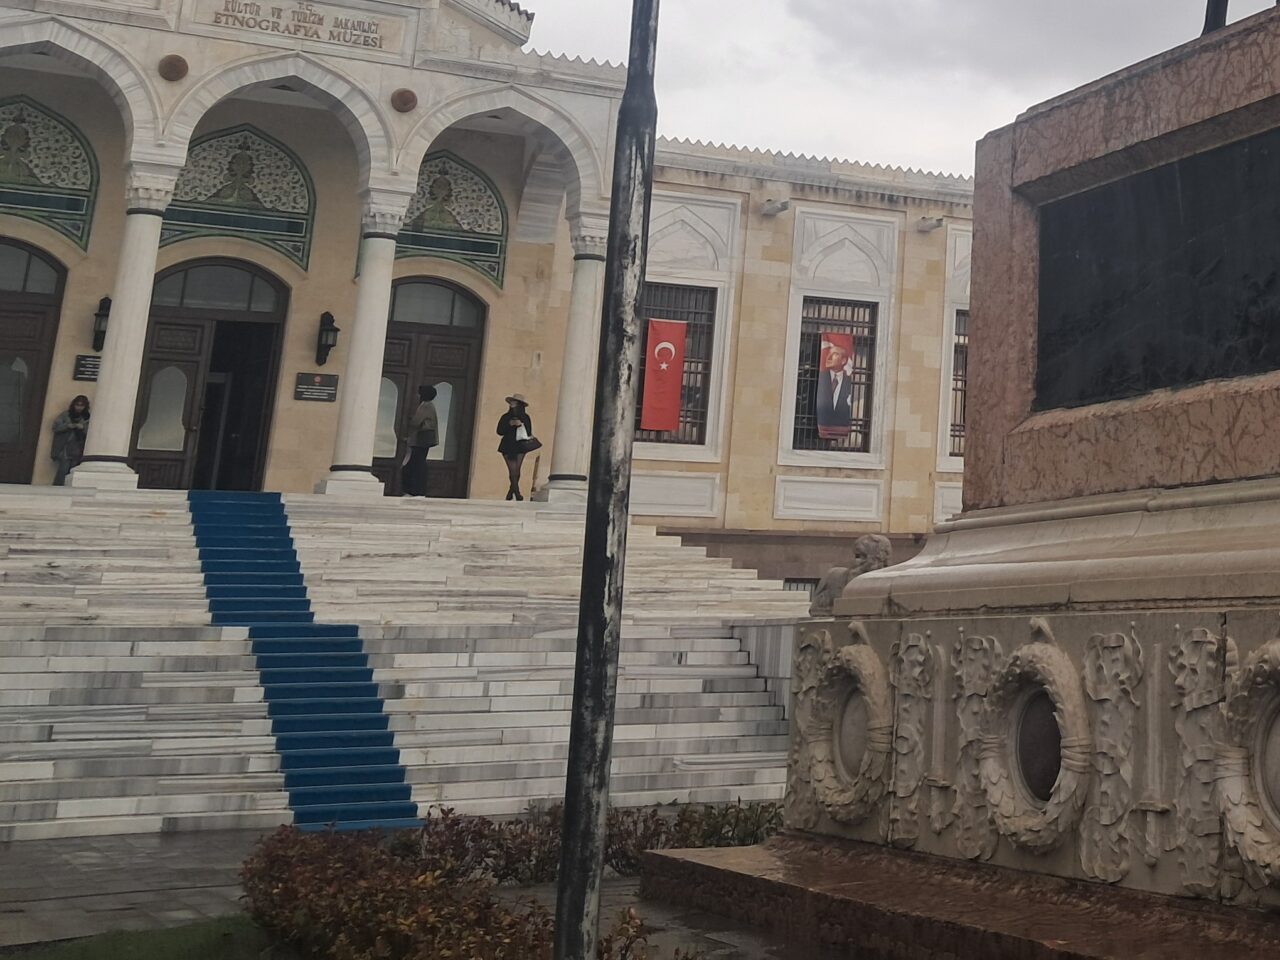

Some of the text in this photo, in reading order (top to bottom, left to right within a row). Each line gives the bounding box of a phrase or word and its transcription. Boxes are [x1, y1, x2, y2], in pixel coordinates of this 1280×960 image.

[271, 7, 283, 19] VE
[213, 11, 383, 48] ETNOGRAFYA MÜZESİ
